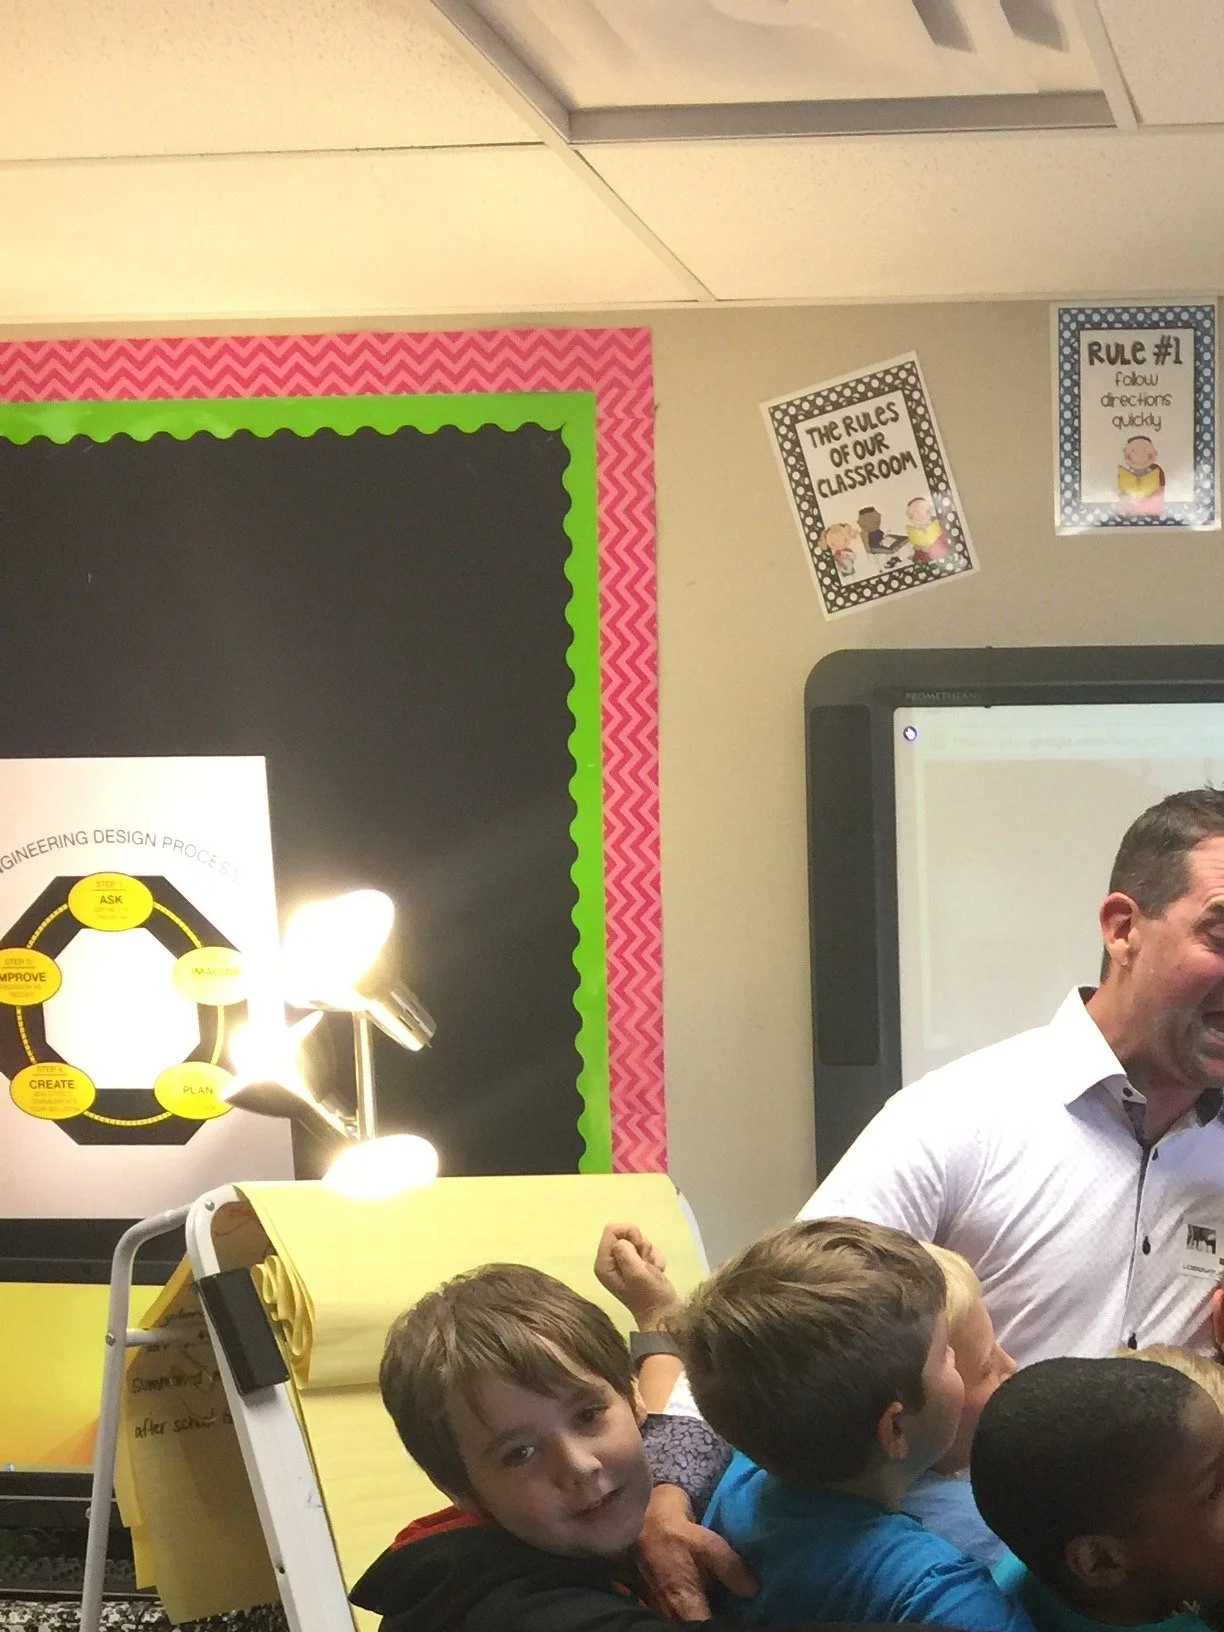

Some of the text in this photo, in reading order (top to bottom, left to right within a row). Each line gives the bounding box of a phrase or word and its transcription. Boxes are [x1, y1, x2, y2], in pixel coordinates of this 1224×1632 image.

[1153, 334, 1183, 366] #1
[1115, 371, 1158, 387] follow
[1101, 392, 1172, 408] directions
[1112, 411, 1162, 432] quickly
[830, 431, 890, 468] OF OUR
[817, 450, 918, 498] CLASSROOM
[93, 829, 157, 848] DESIGN
[100, 895, 123, 905] ASK
[29, 1079, 75, 1089] CREATE
[183, 1086, 214, 1095] PLAN
[135, 1417, 166, 1439] after
